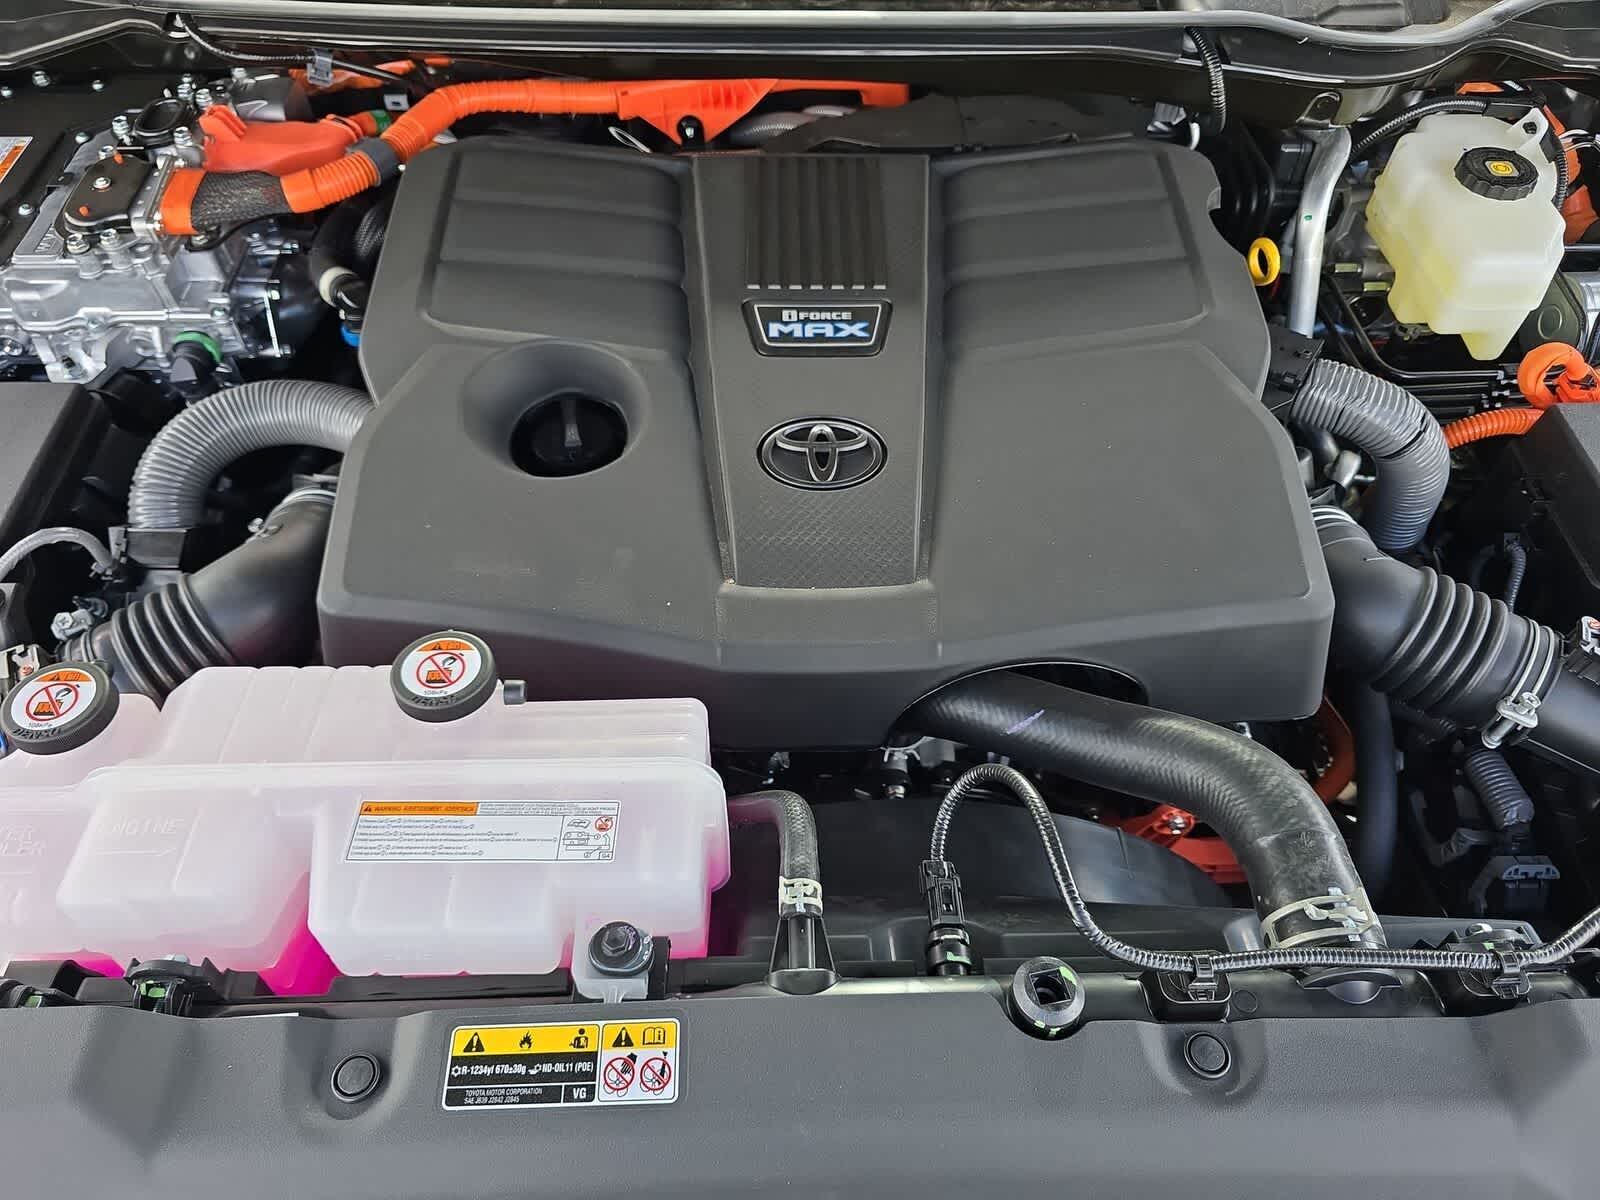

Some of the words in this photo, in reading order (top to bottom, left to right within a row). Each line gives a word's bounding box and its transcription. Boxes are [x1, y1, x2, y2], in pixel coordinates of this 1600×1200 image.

[768, 322, 869, 337] MAX
[460, 1065, 494, 1076] R-1234yf
[495, 1064, 527, 1076] 670±30g
[542, 1062, 574, 1073] ND-OIL11
[574, 1061, 594, 1073] (POE)
[465, 1089, 486, 1097] TOYOTA
[505, 1087, 543, 1096] CORPORATION
[572, 1088, 587, 1099] VG
[463, 1097, 475, 1105] SAE
